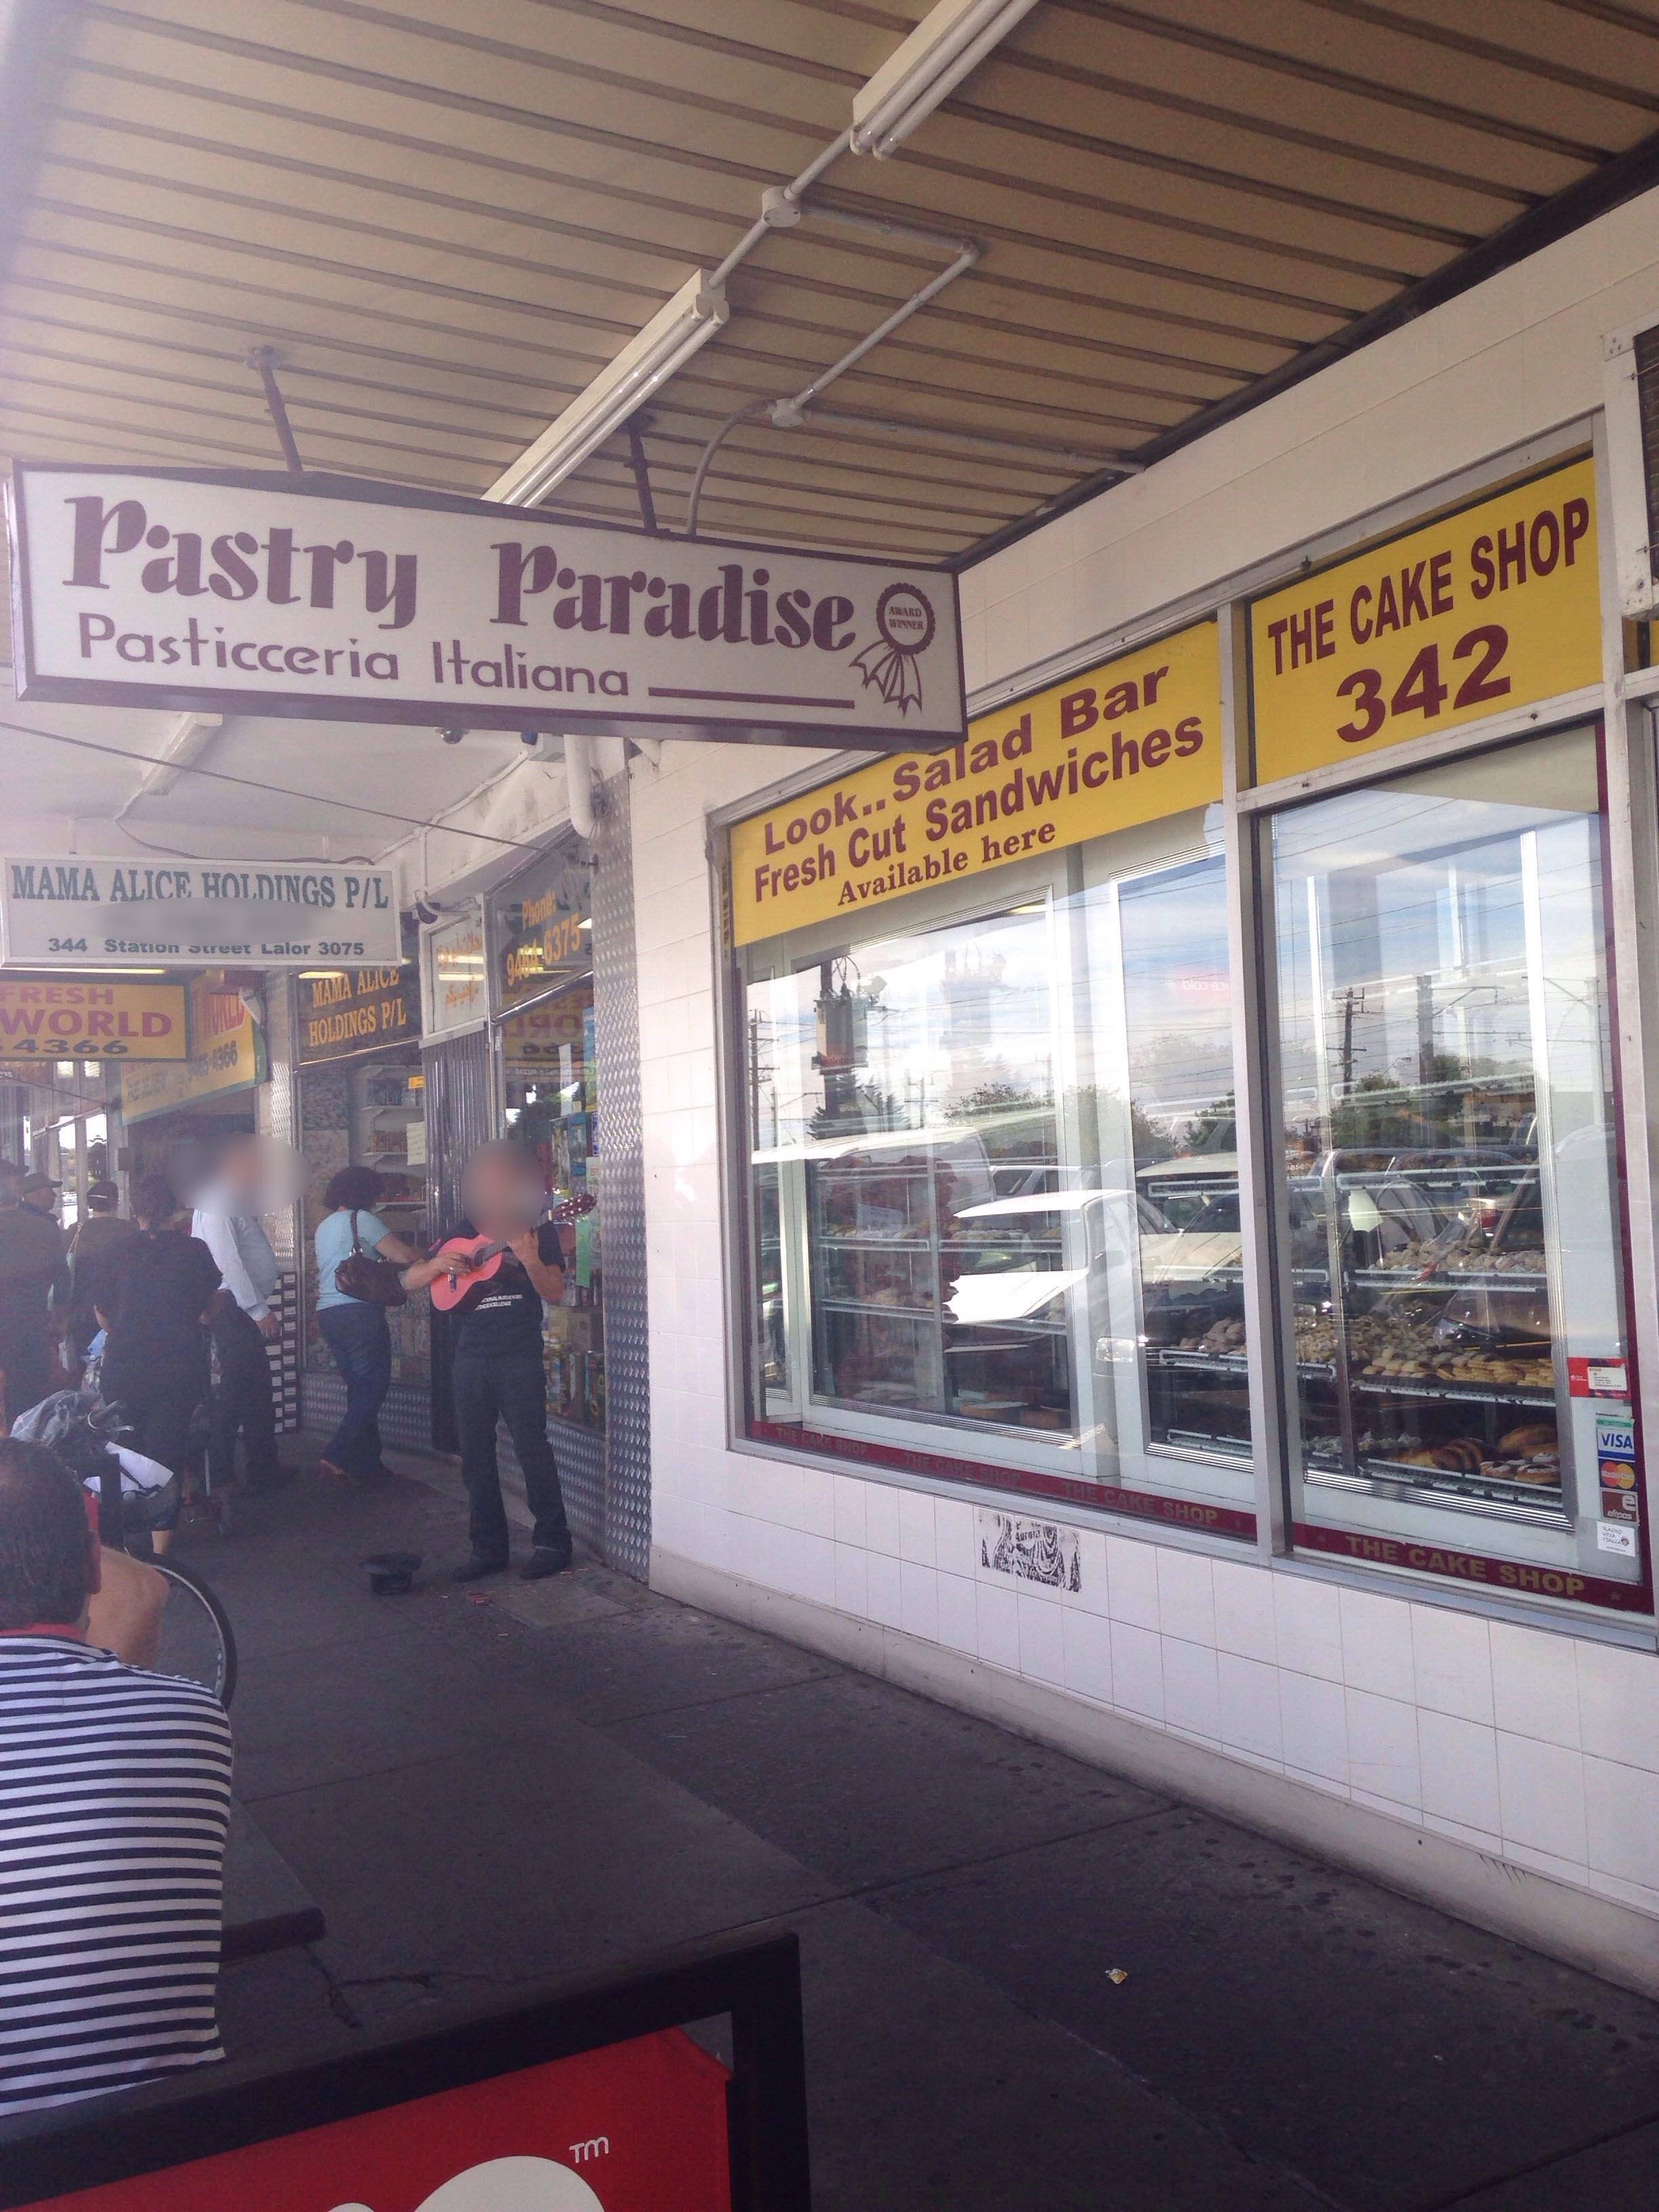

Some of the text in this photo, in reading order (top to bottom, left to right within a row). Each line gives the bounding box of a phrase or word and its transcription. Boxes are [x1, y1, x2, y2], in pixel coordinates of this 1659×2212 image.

[62, 495, 856, 651] Pastry Paradise
[1268, 497, 1590, 676] THE CAKE SHOP
[888, 606, 922, 617] AWARD
[888, 618, 924, 630] WINNER
[79, 612, 629, 696] Pasticceria Italiana
[1336, 623, 1511, 743] 342
[893, 713, 1033, 802] Salad
[1060, 665, 1170, 739] Bar
[754, 716, 1204, 903] Fresh Cut Sandwiches
[837, 821, 1057, 906] Available here
[12, 865, 389, 909] MAMA ALICE HOLDINGS P/L
[48, 938, 88, 952] 344
[104, 939, 180, 954] Station
[261, 941, 311, 956] Lalor
[318, 942, 365, 956] 3075
[544, 912, 581, 966] 6375
[0, 985, 114, 1005] FRESH
[312, 966, 400, 1008] MAMA ALICE
[0, 1008, 173, 1038] WORLD
[309, 997, 407, 1048] HOLDINGS P/L
[776, 1426, 868, 1456] THE CAKE SHOP
[903, 1452, 930, 1471] THE
[1601, 1433, 1633, 1450] VISA
[1064, 1481, 1218, 1525] THE CAKE SHOP
[1607, 1510, 1633, 1521] eftpos
[1345, 1535, 1586, 1596] THE CAKE SHOP
[569, 2135, 610, 2164] TM
